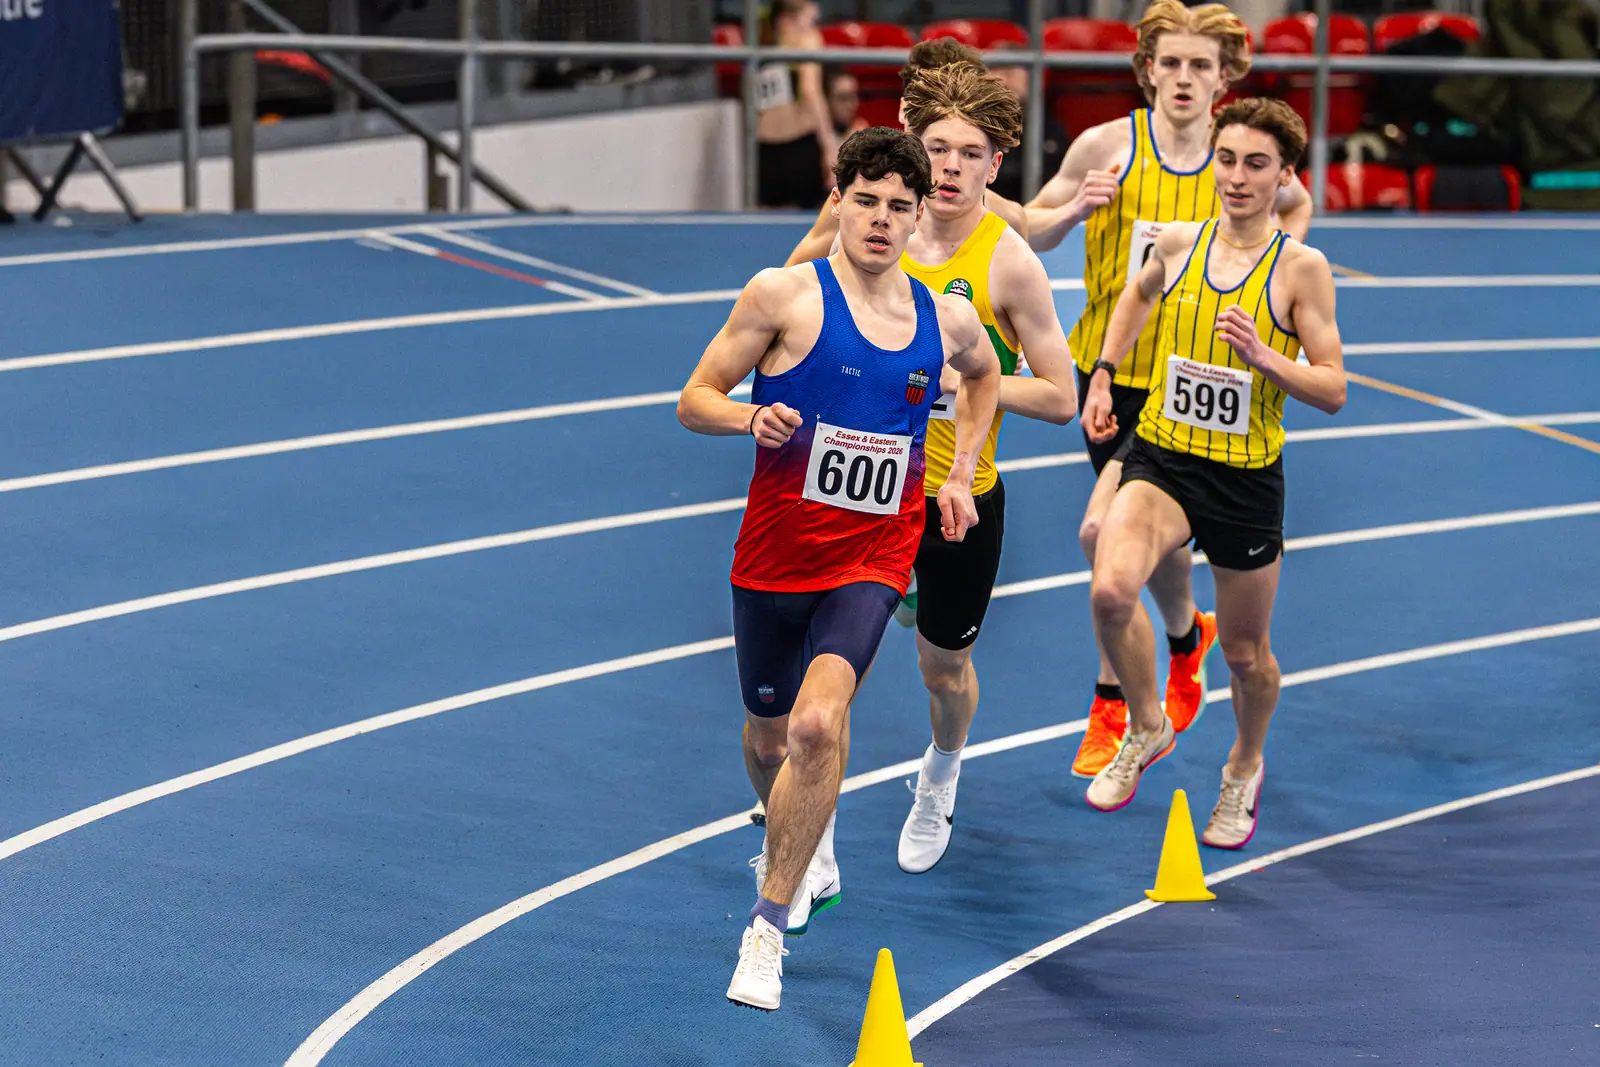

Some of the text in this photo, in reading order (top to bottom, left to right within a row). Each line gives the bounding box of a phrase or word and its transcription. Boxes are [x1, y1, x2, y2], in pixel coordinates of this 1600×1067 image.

[841, 365, 861, 377] TACTIC
[1173, 375, 1240, 426] 599
[823, 436, 904, 455] Championships 2026
[835, 430, 898, 446] Essex & Eastern
[817, 449, 898, 506] 600
